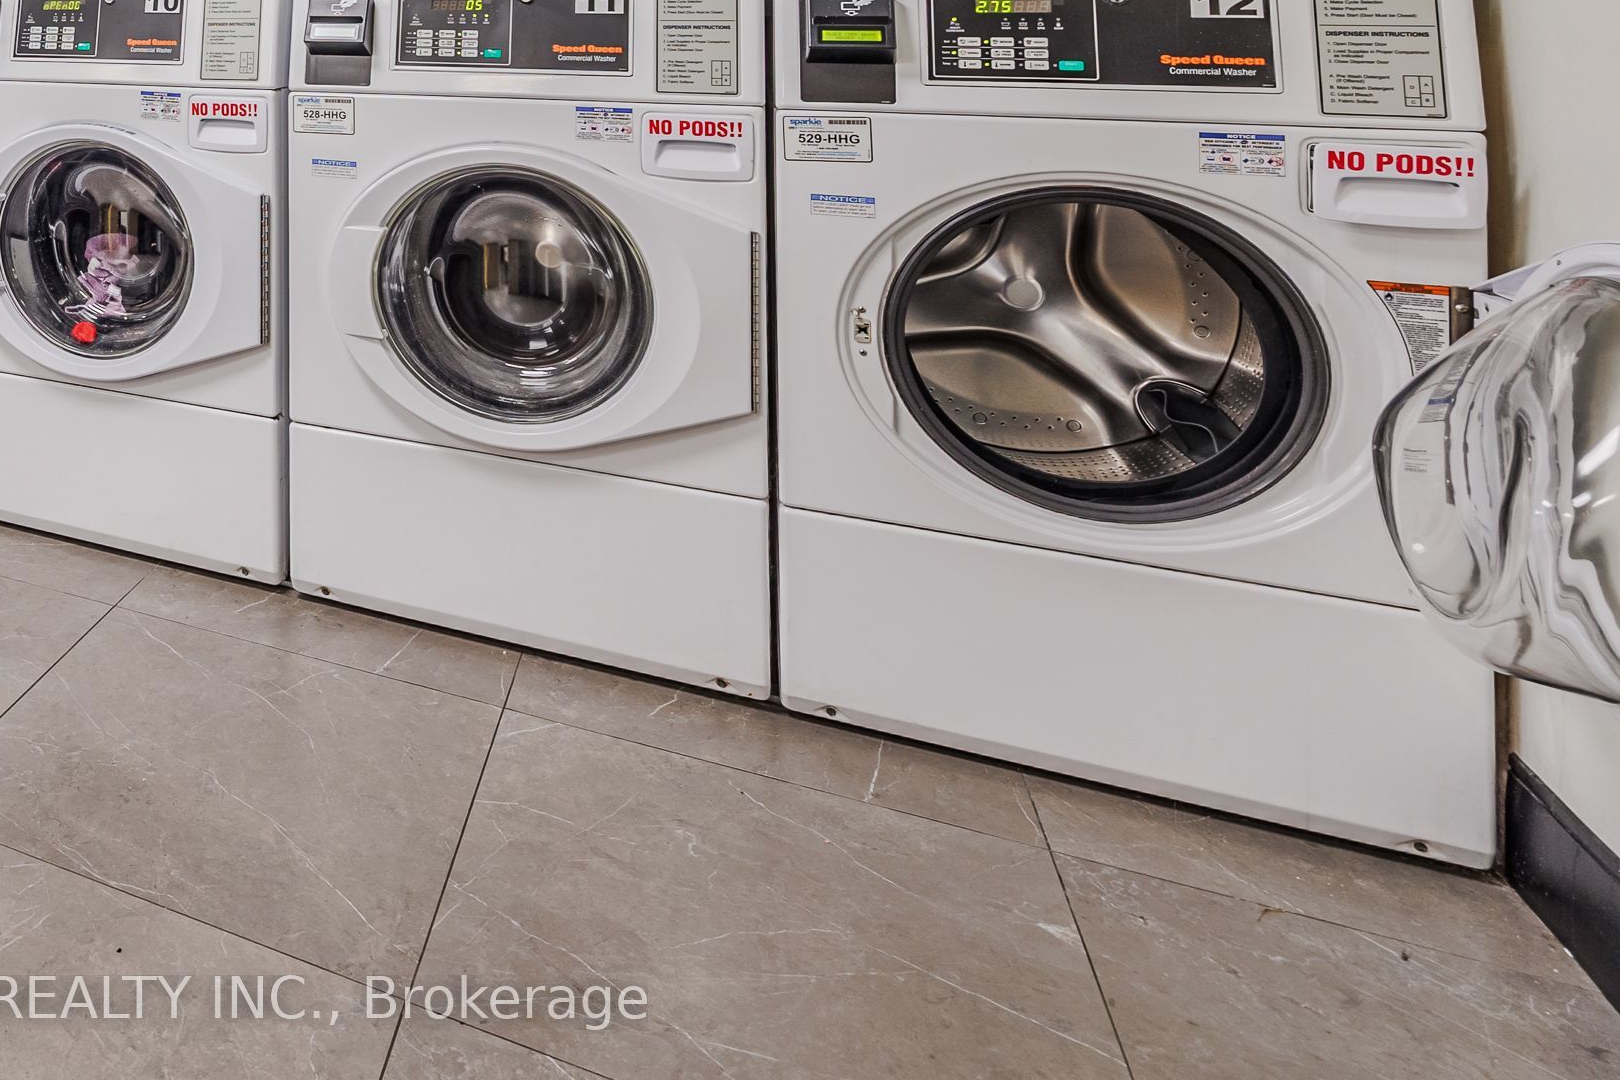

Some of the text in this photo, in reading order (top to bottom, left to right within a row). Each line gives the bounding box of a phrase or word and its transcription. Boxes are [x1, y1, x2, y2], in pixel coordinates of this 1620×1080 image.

[465, 0, 483, 11] 05
[976, 0, 1011, 13] 2.75
[552, 45, 623, 54] Speed Queen
[1160, 55, 1265, 66] Speed Queen
[1169, 67, 1257, 76] Commercial Washer
[192, 103, 208, 116] NO
[212, 103, 258, 117] PODS!!
[303, 110, 347, 120] 528-HHG
[649, 119, 673, 135] NO
[679, 120, 743, 138] PODS!!
[798, 133, 860, 144] 529-HHG
[1328, 150, 1475, 177] NO PODS!!
[819, 195, 866, 203] NOTICE
